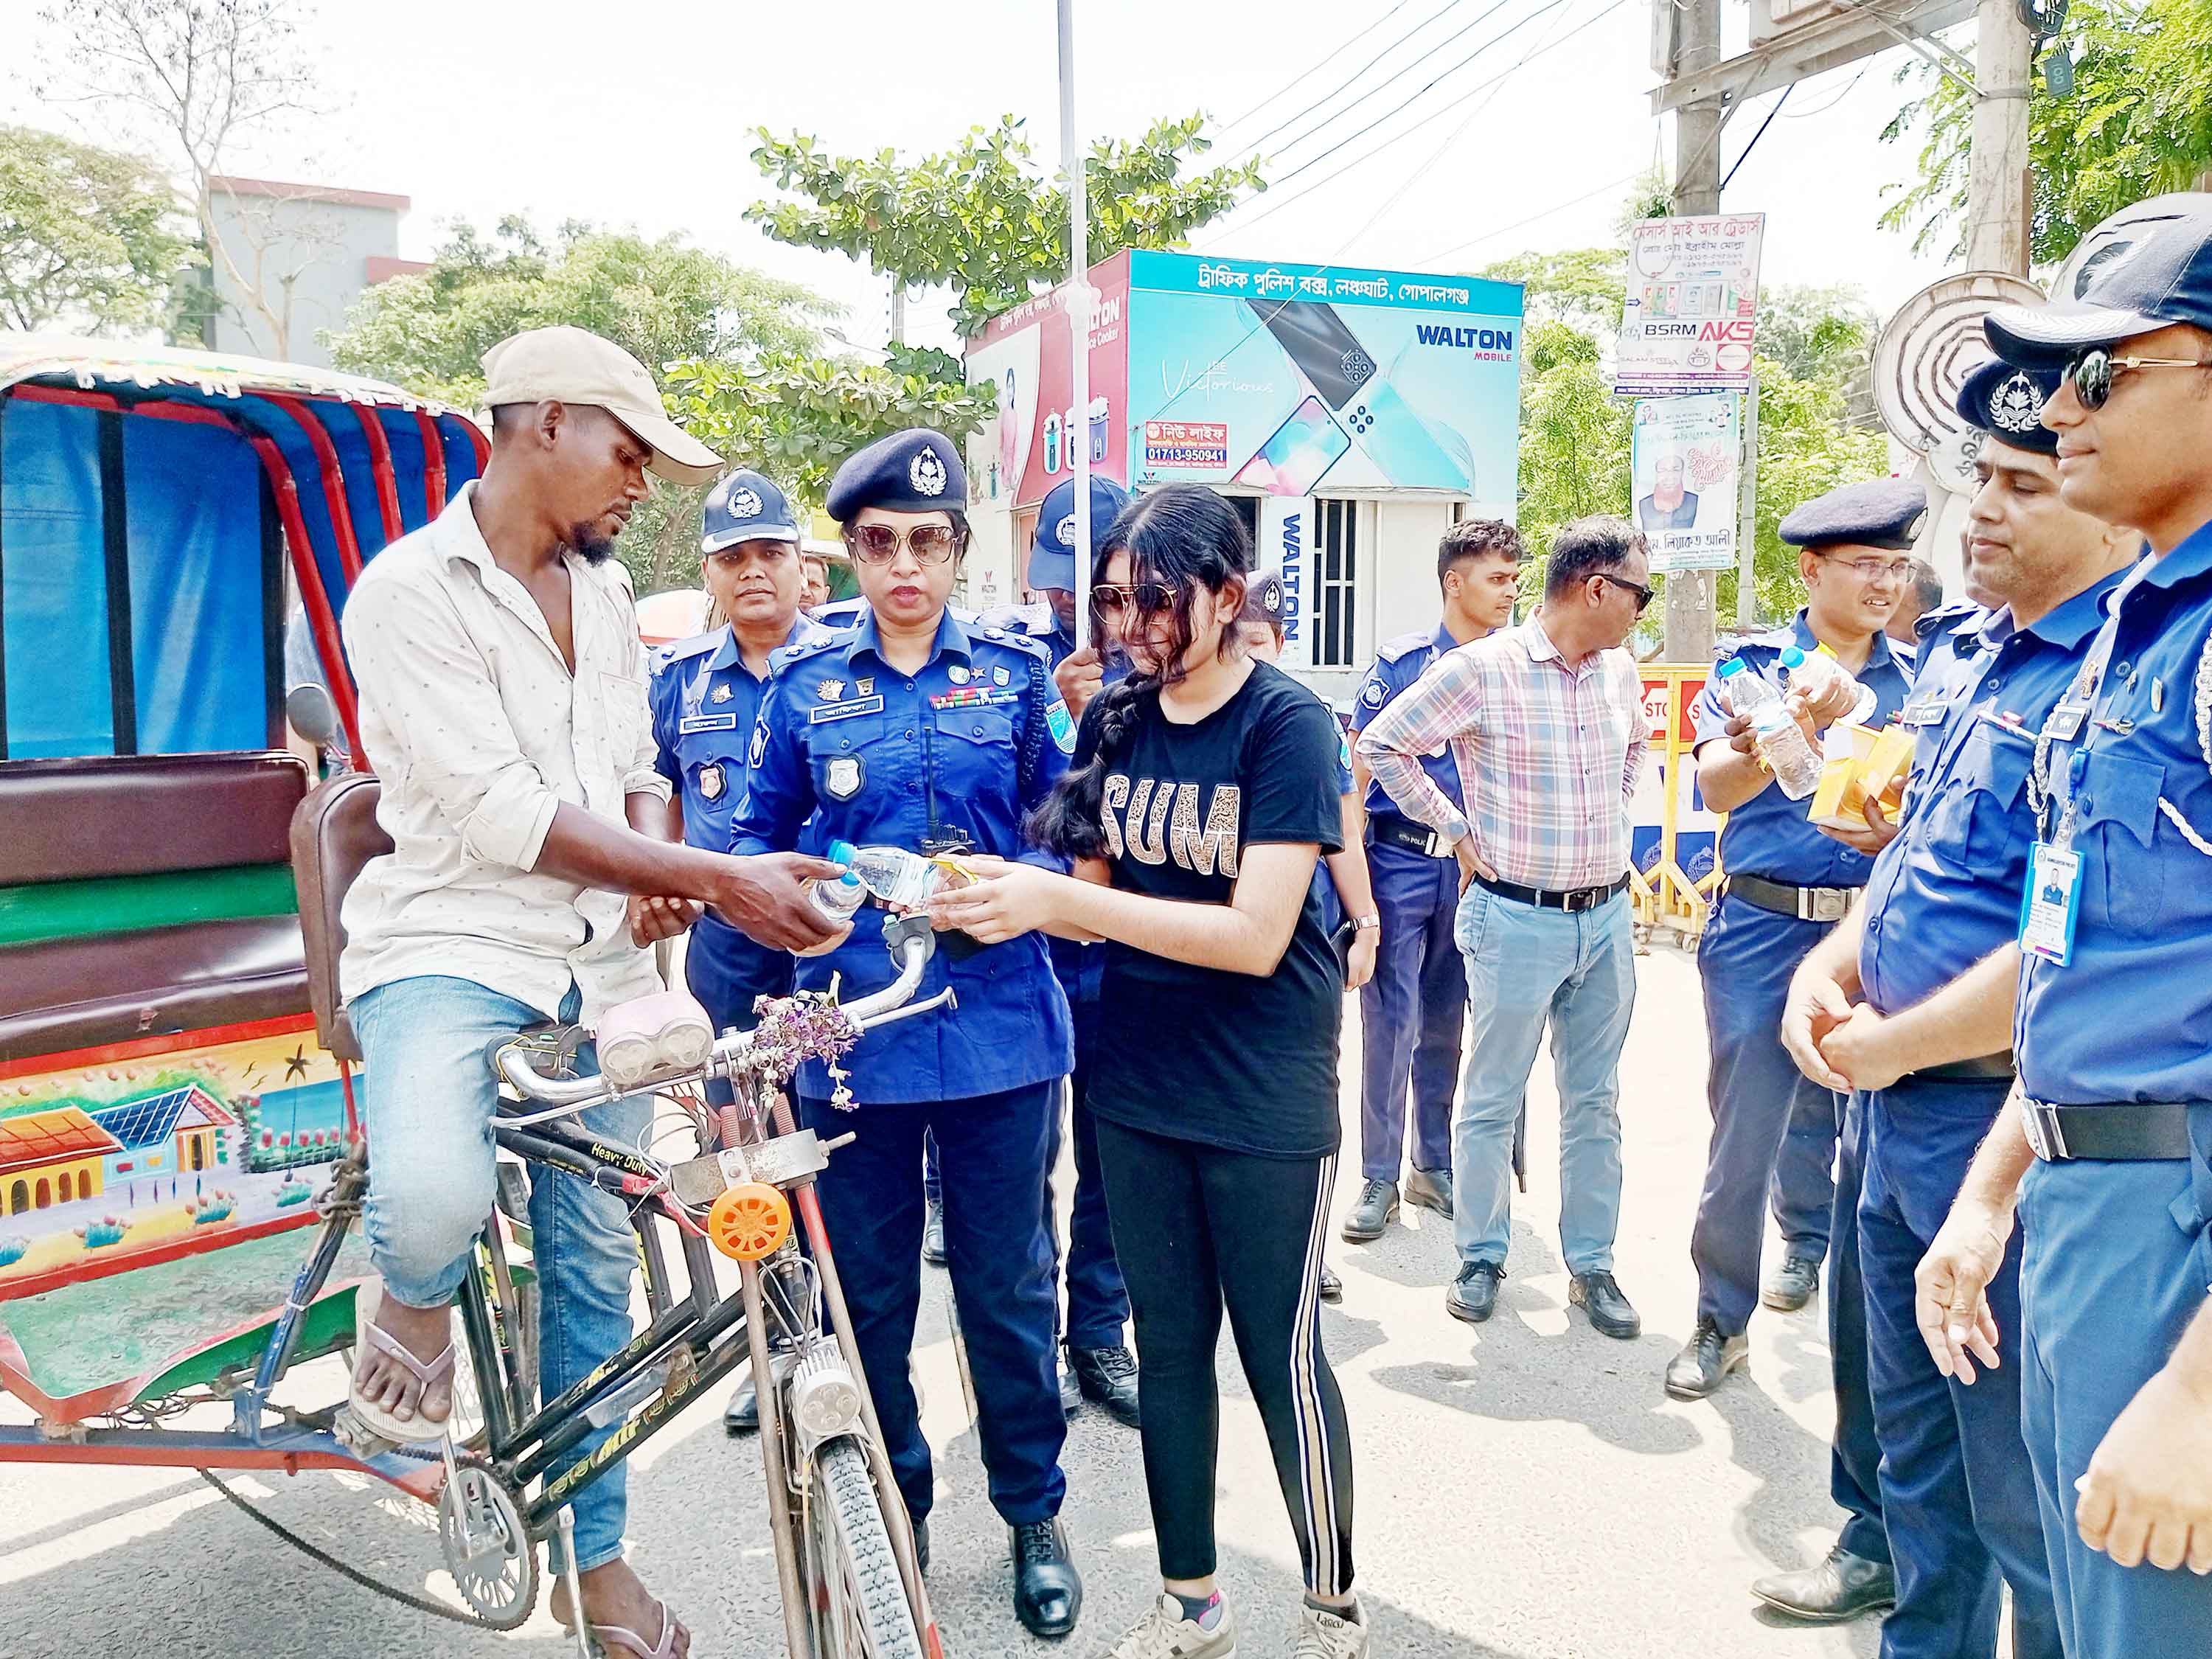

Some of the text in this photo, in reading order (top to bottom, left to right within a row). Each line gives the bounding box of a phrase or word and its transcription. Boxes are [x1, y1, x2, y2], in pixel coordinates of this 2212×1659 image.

[1698, 223, 1721, 237] আর
[1198, 265, 1248, 288] ট্রাফিক
[1253, 268, 1295, 294] পুলিশ
[1399, 283, 1469, 306] গোপালগঞ্জ
[1416, 324, 1512, 350] WALTON
[1645, 324, 1697, 335] BSRM
[1699, 321, 1753, 341] AKS
[1475, 352, 1512, 362] MOBILE
[1161, 423, 1225, 441] নিউ লাইফ
[1148, 448, 1224, 461] 01713-950941
[1282, 513, 1301, 641] WALTON
[591, 1142, 623, 1167] Heavy
[624, 1155, 648, 1177] Duty
